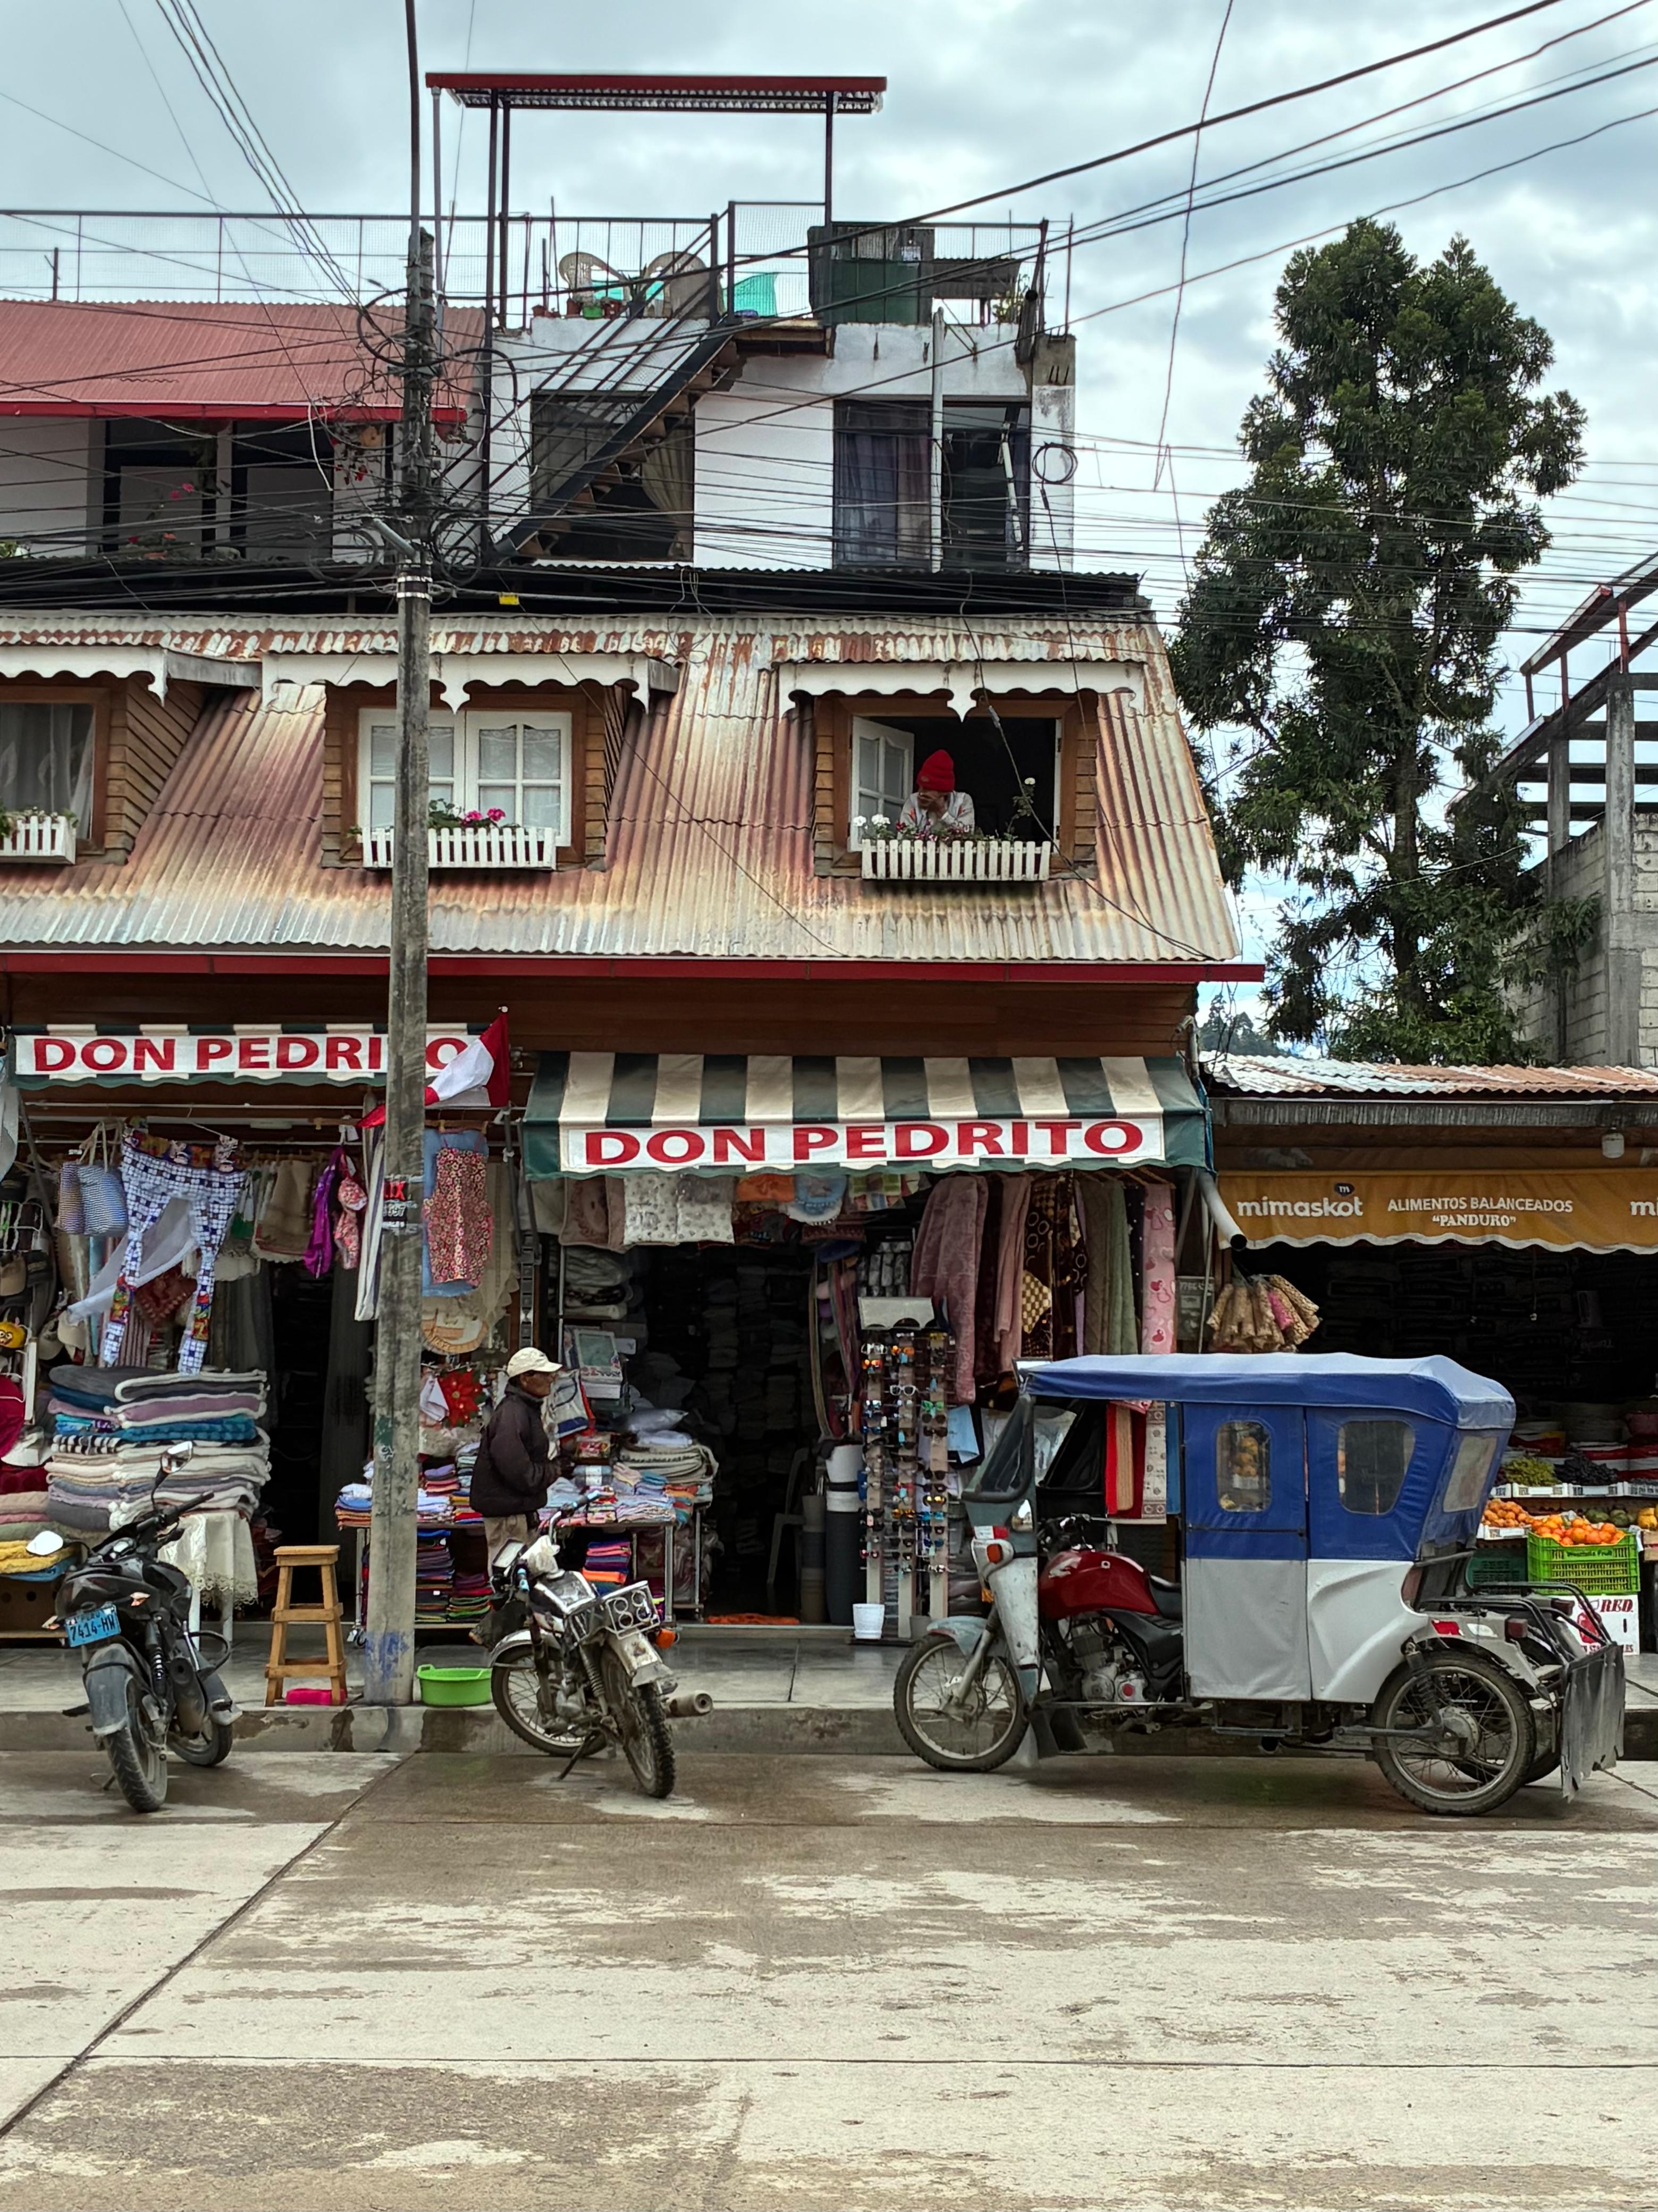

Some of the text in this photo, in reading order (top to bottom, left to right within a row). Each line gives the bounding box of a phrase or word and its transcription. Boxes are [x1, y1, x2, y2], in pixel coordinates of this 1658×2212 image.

[33, 1037, 467, 1071] DON PEDRIO
[585, 1121, 1143, 1165] DON PEDRITO
[1237, 1196, 1363, 1217] mimaskot
[1387, 1197, 1573, 1213] ALIMENTOS BALANCEADOS
